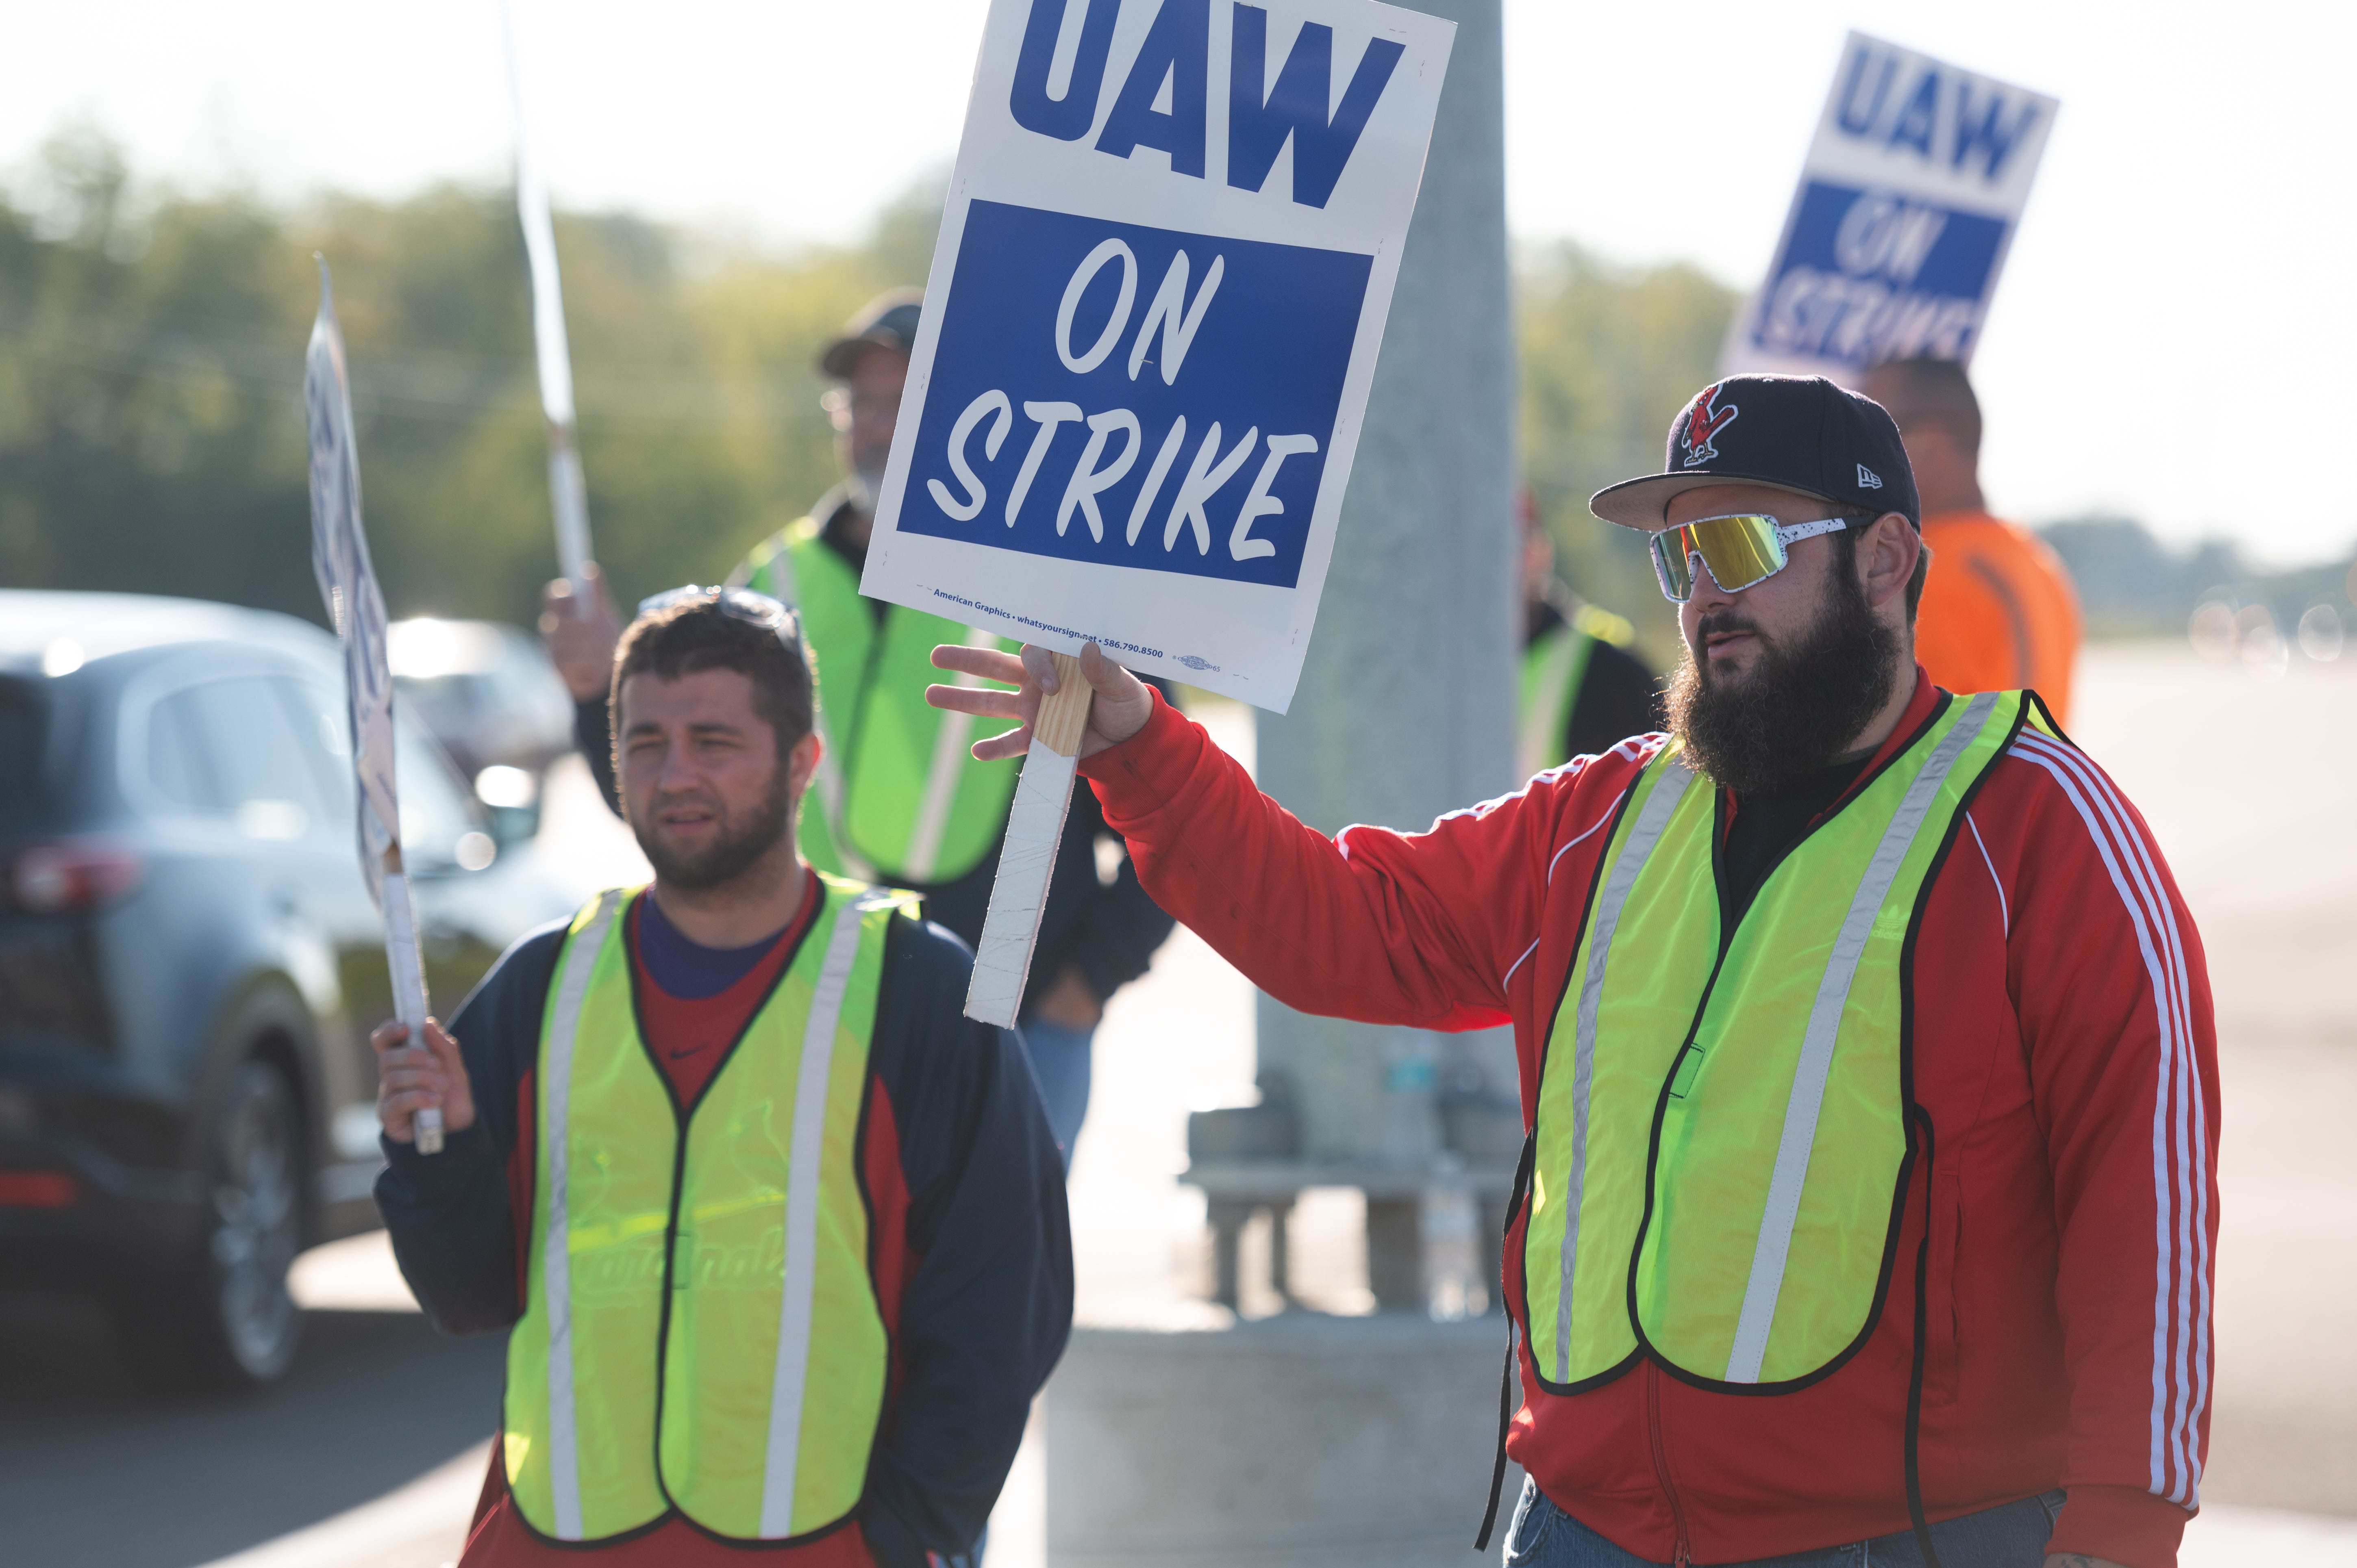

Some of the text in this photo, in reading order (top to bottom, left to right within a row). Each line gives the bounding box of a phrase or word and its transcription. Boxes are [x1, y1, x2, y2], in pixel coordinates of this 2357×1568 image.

[1009, 0, 1407, 210] UAW
[1835, 46, 2041, 185] UAW
[1833, 188, 1950, 287] ON
[1055, 237, 1224, 386] ON
[926, 389, 1318, 561] STRIKE
[933, 589, 1163, 658] American Graphics whatsyoursign.net 586.790.8500
[1871, 928, 1905, 941] didas
